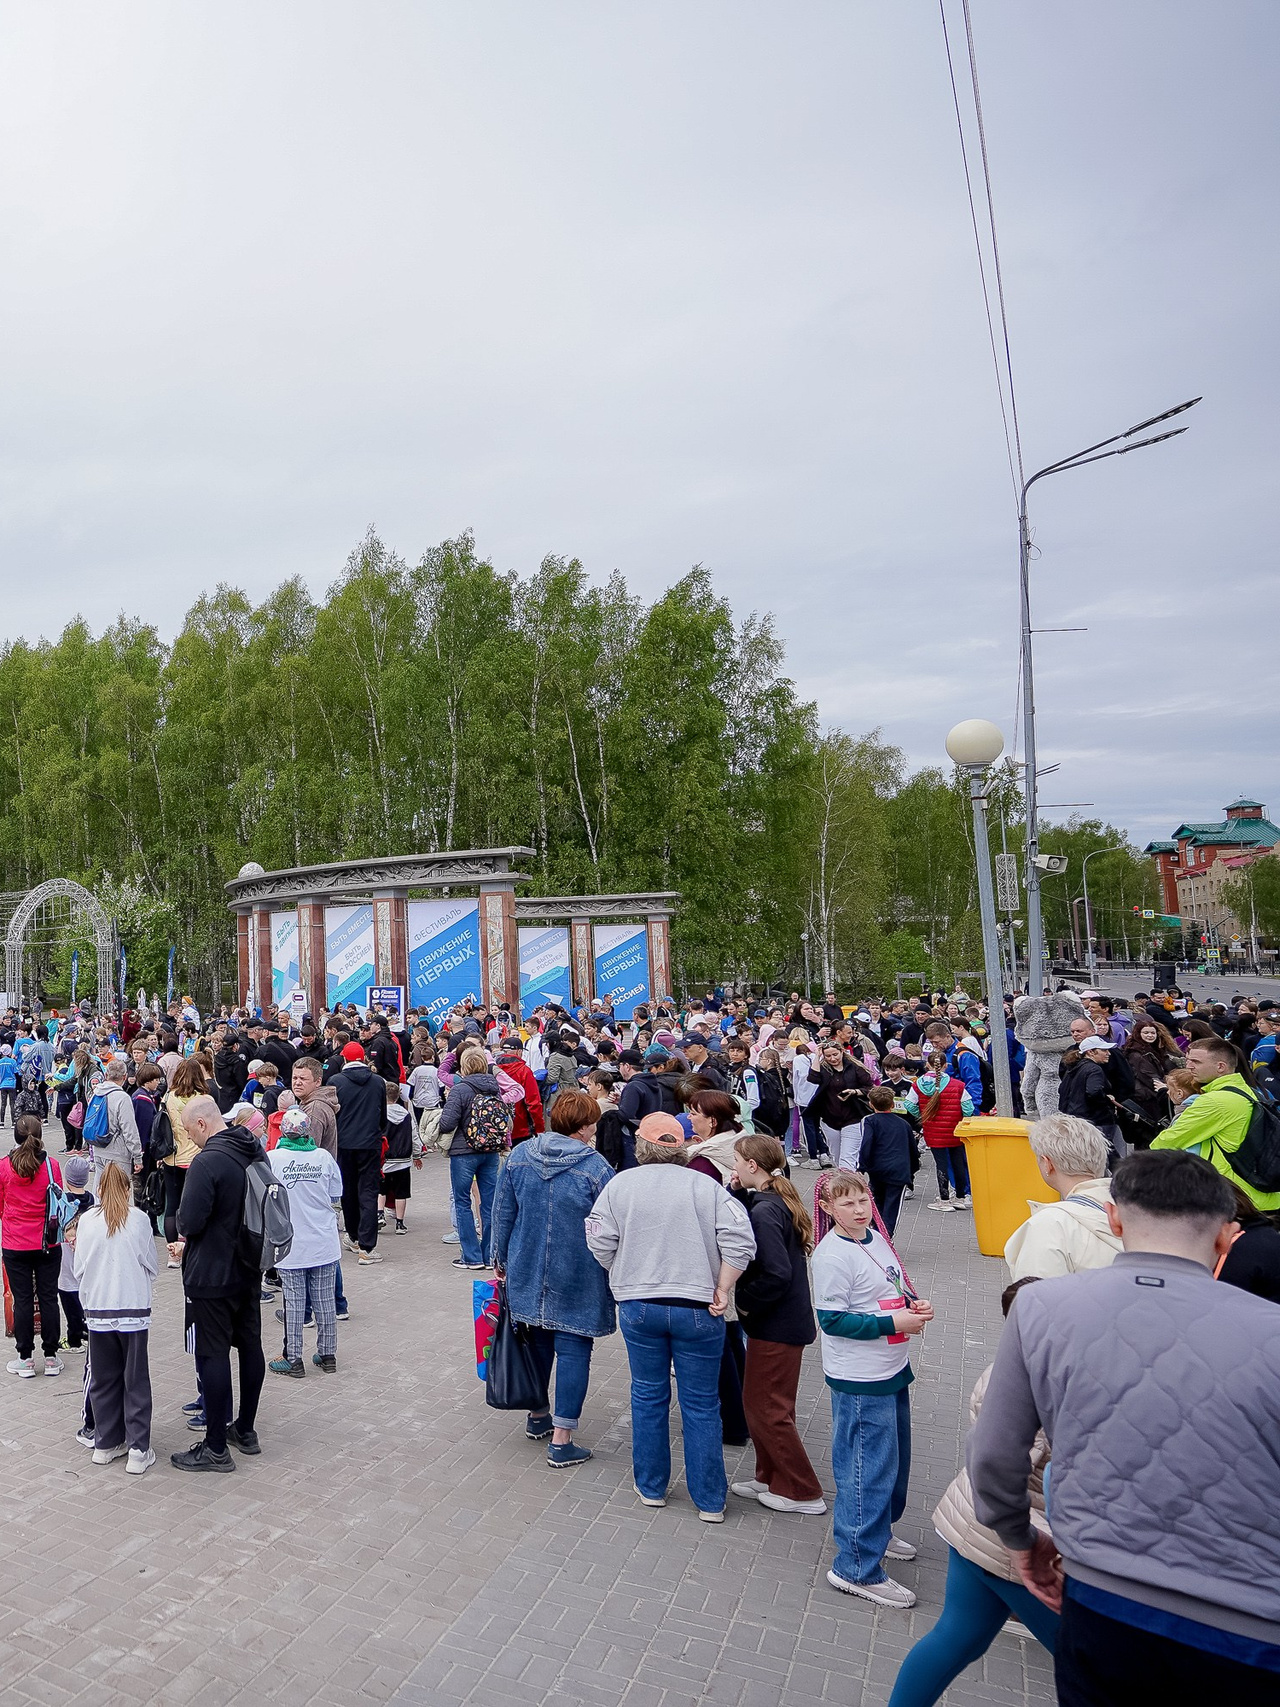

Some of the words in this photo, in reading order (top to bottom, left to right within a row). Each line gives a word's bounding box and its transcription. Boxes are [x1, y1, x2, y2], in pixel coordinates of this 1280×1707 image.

[276, 920, 291, 939] БЫТЬ
[330, 933, 348, 950] БЫТЬ
[347, 910, 372, 936] ВМЕСТЕ
[414, 908, 462, 942] ФЕСТИВАЛЬ
[344, 944, 362, 960] БЫТЬ
[345, 943, 373, 970] РОССИЕЙ
[418, 929, 473, 970] ДВИЖЕНИЕ
[601, 943, 642, 970] ДВИЖЕНИЕ
[415, 944, 476, 989] ПЕРВЫХ
[600, 953, 644, 982] ПЕРВЫХ
[426, 996, 450, 1015] ЫТЬ
[603, 986, 626, 999] ЫТЬ
[610, 983, 646, 1006] ОССИЕЙ
[282, 1160, 322, 1173] Активный
